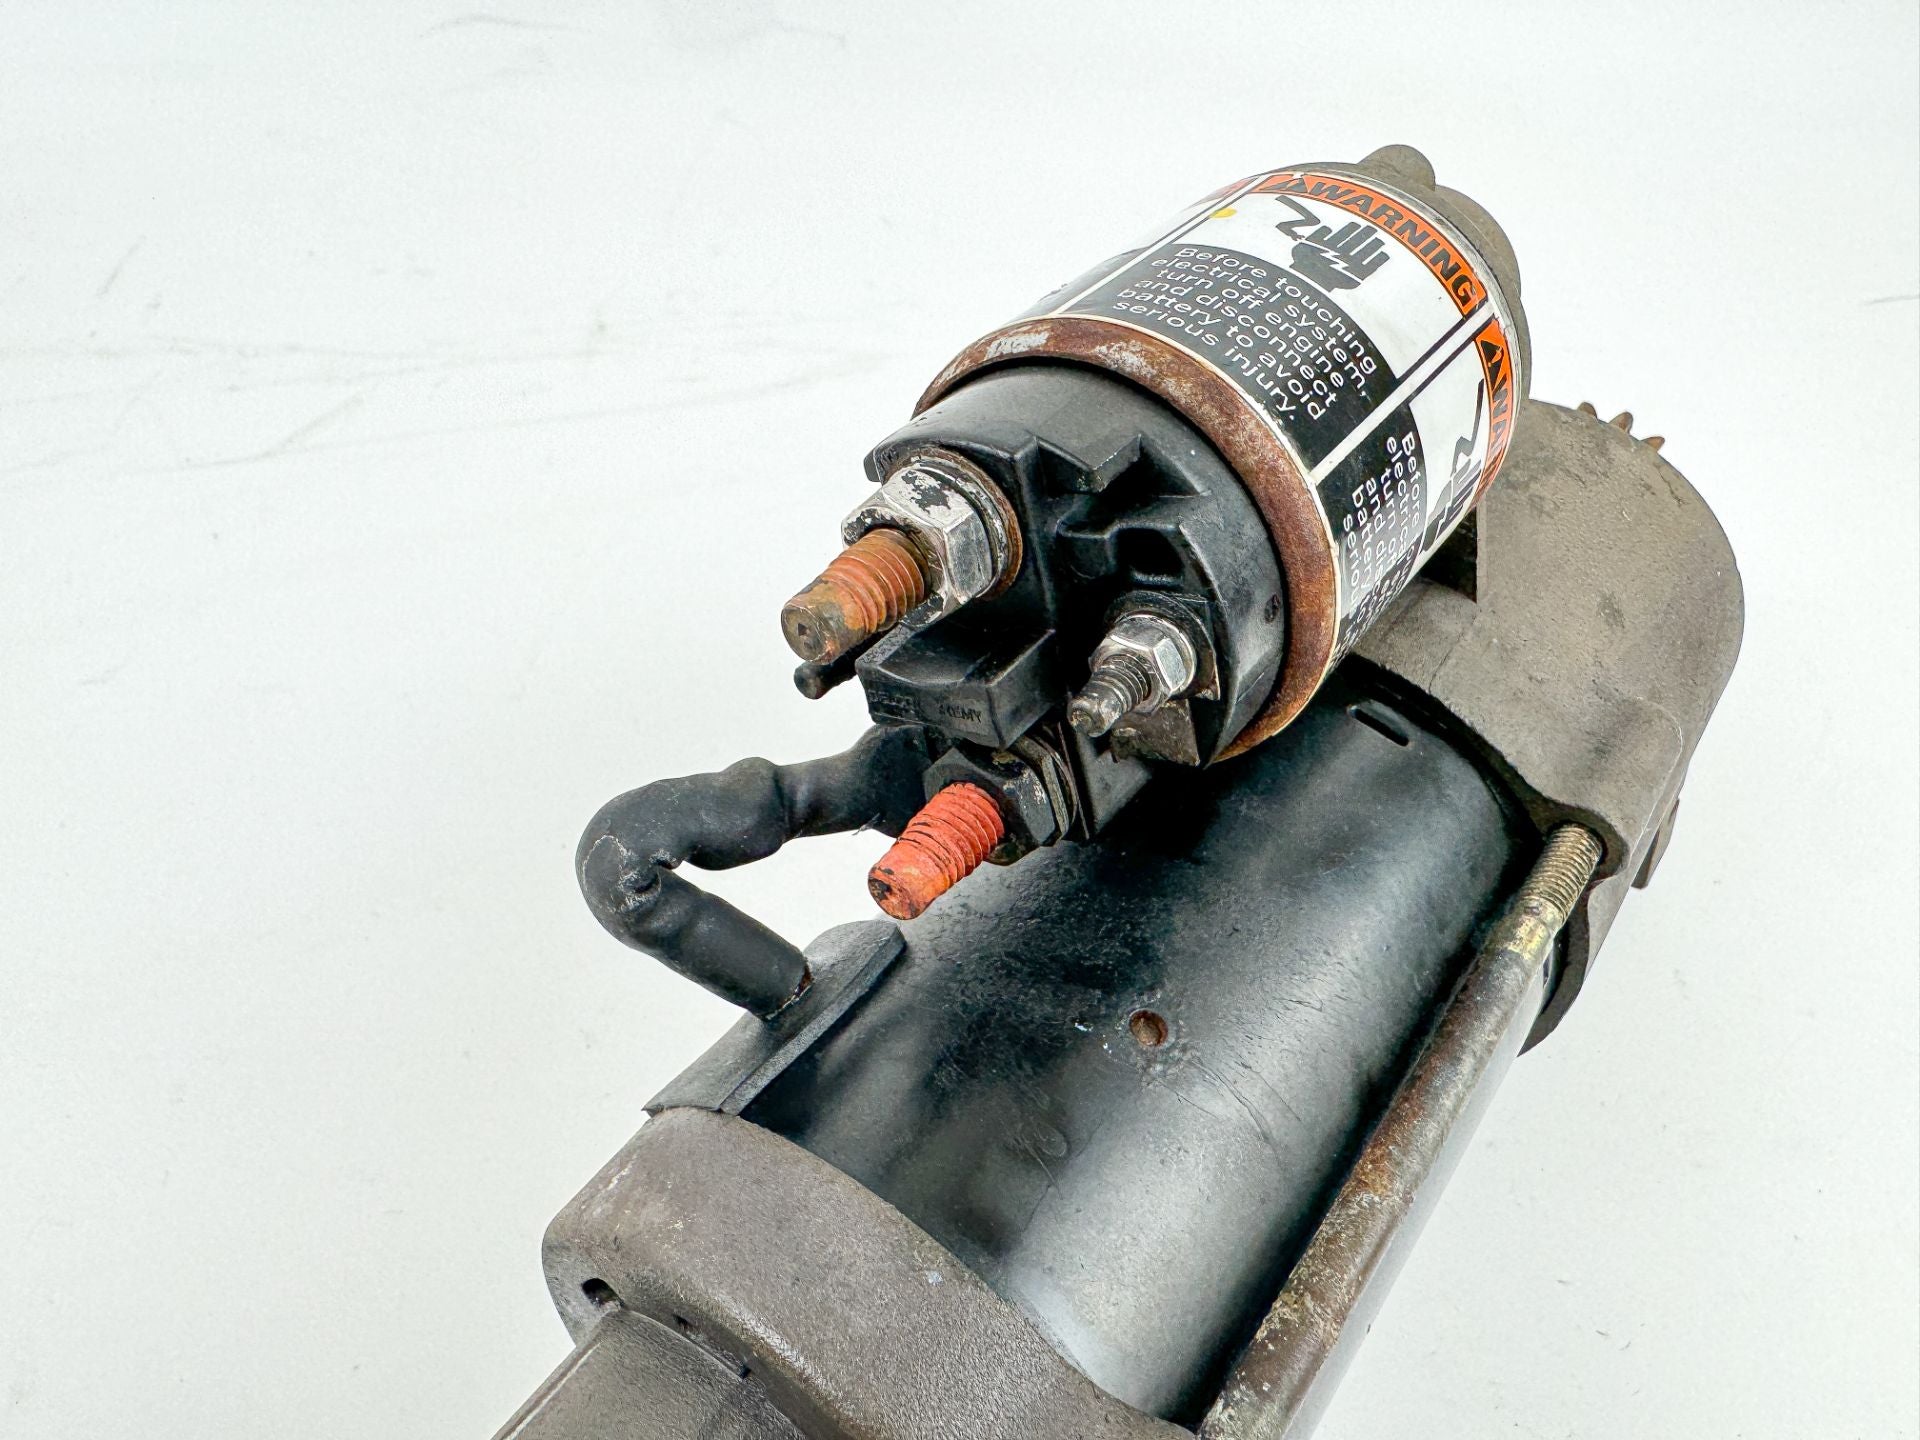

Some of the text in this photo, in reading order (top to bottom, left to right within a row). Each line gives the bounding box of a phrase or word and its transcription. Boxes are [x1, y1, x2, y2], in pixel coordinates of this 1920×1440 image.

[1308, 181, 1474, 306] WARNING
[1112, 302, 1296, 420] serious injury.
[1117, 288, 1326, 420] battery to avoid
[1134, 280, 1336, 407] and disconnect
[1151, 258, 1367, 397] electrical system,
[1157, 268, 1344, 388] turn off engine
[1174, 248, 1377, 374] Before touching
[1352, 484, 1373, 588] battery
[1366, 477, 1386, 533] and
[1381, 467, 1396, 530] turn
[1386, 436, 1411, 565] electrical
[1401, 431, 1421, 528] Before
